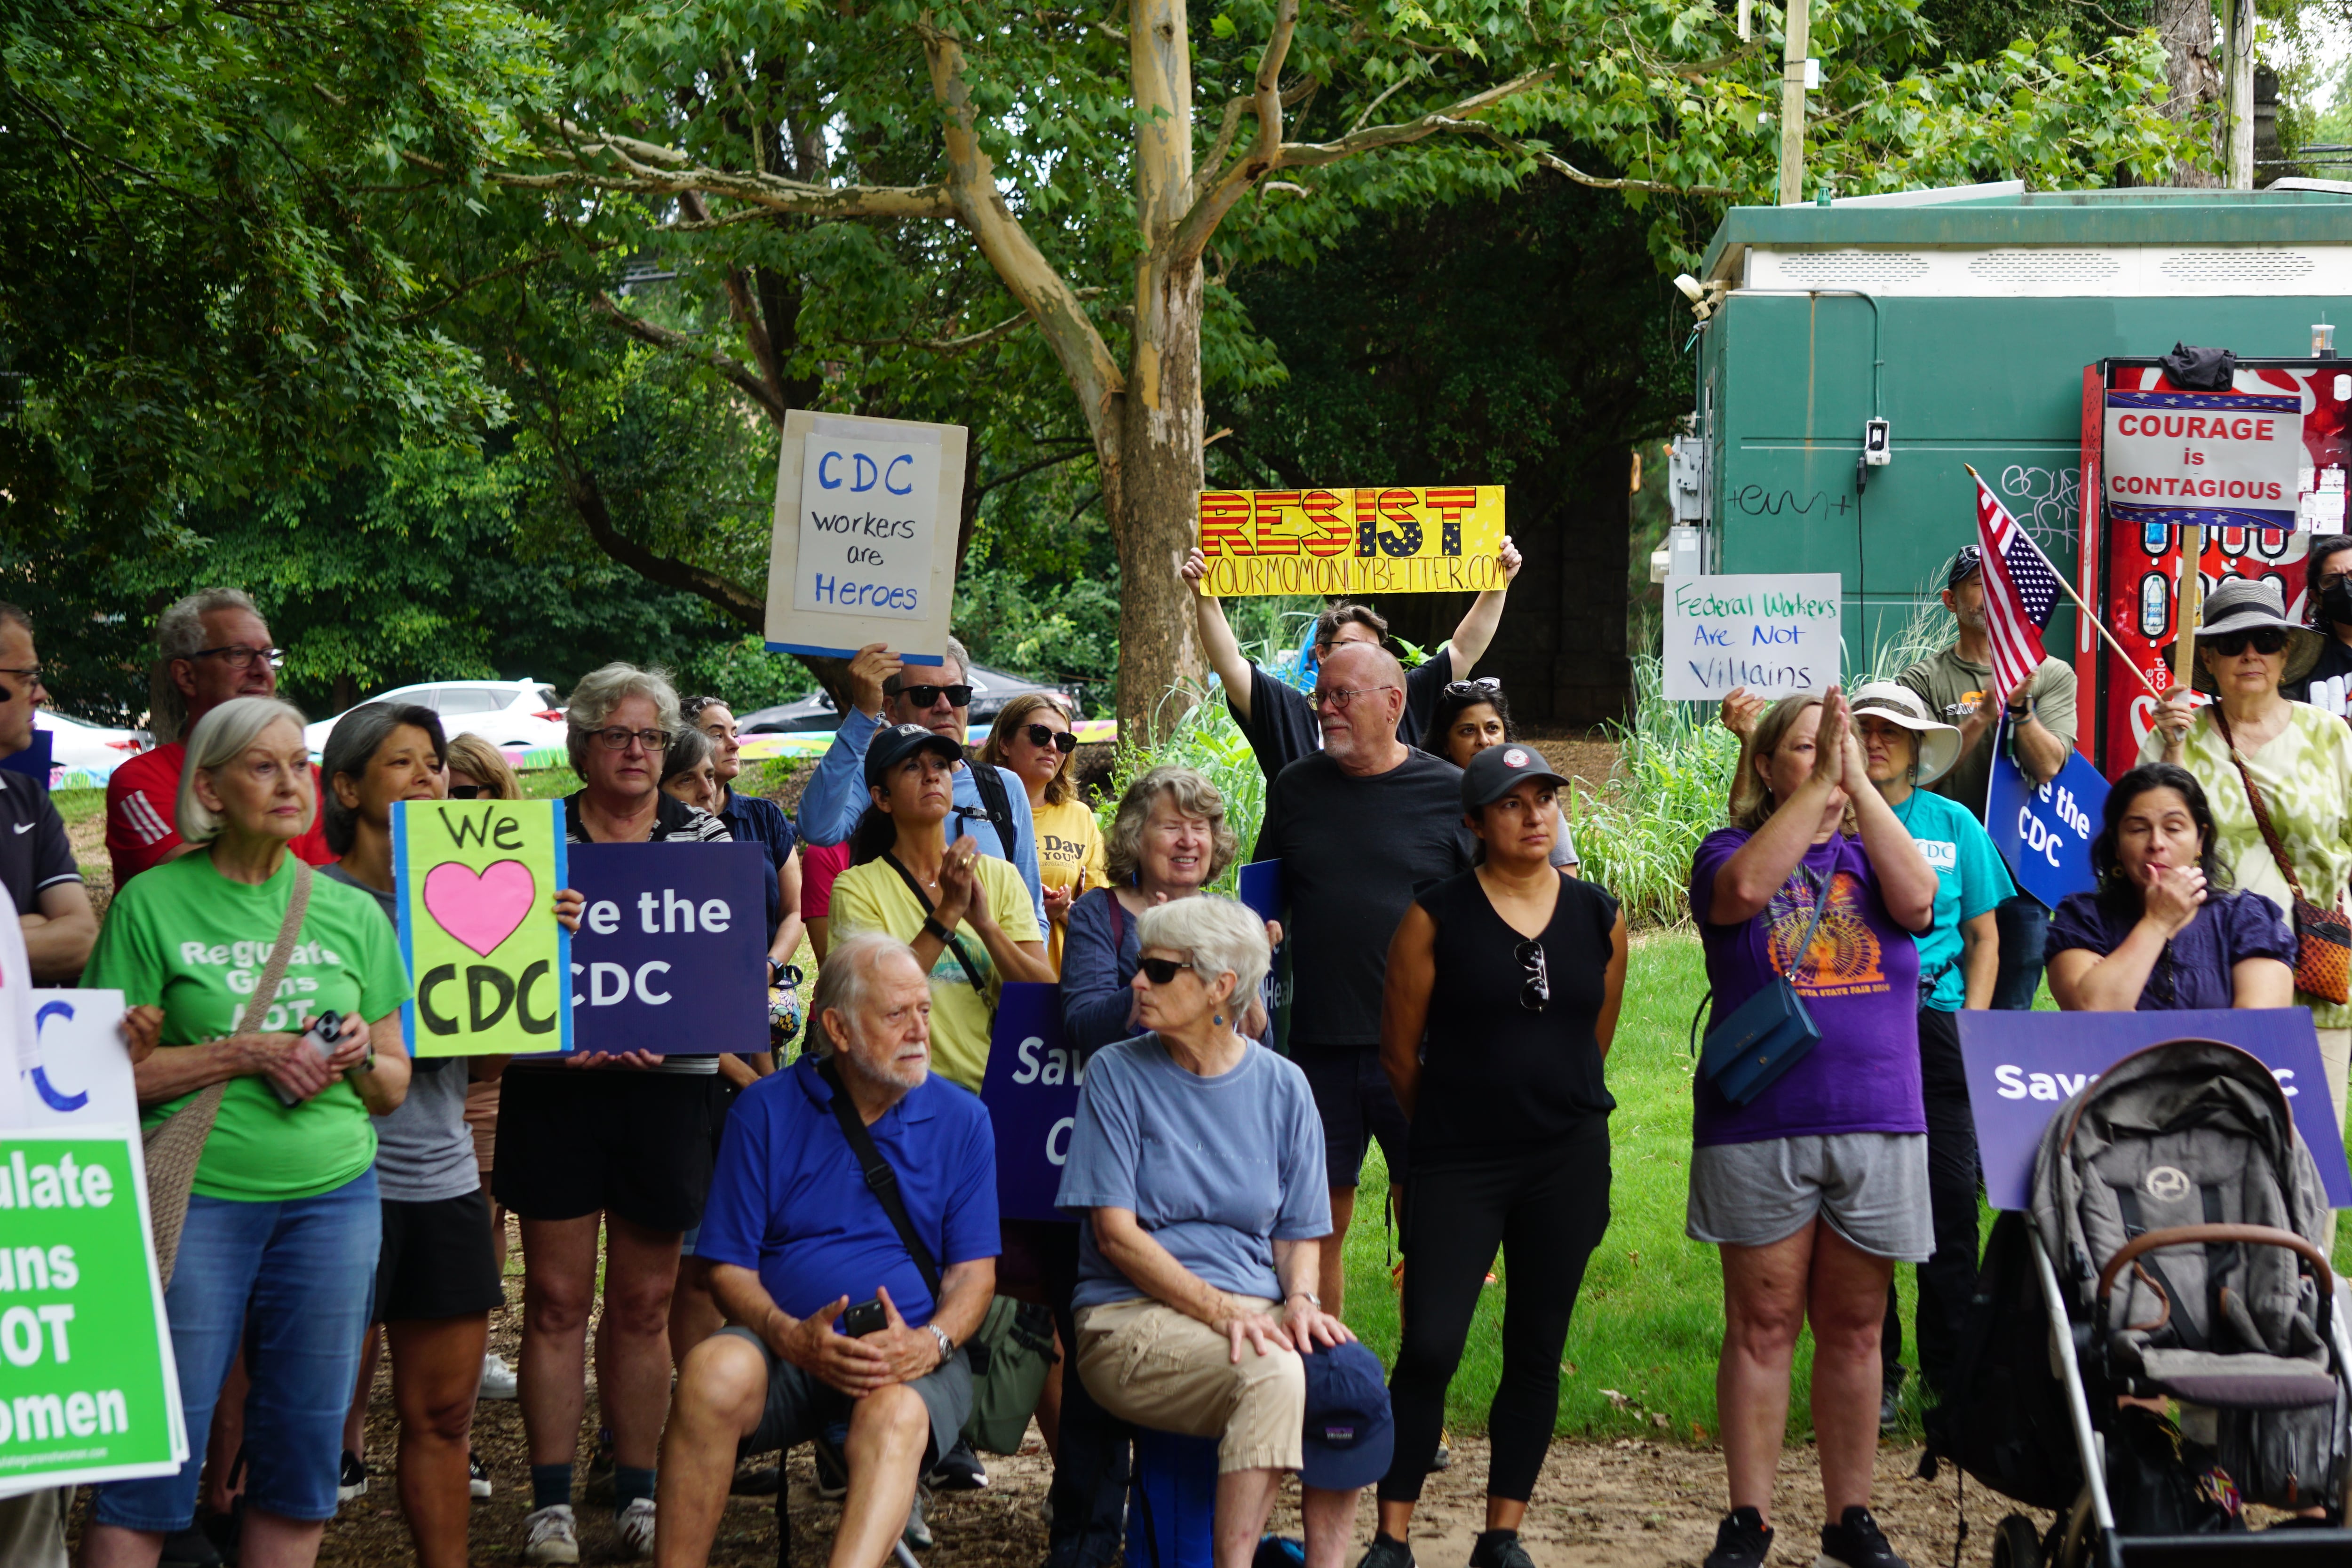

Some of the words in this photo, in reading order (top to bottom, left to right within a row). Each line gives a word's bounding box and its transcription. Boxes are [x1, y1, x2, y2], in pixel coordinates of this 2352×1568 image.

[2118, 414, 2275, 441] COURAGE
[2184, 447, 2204, 466] is
[819, 451, 914, 495] CDC
[2112, 475, 2282, 501] CONTAGIOUS
[811, 511, 915, 539] workers
[1200, 487, 1477, 557] RESIST
[847, 546, 884, 565] are
[816, 573, 917, 610] Heroes
[1675, 582, 1753, 618] Federal
[1763, 592, 1836, 620] Workers
[1694, 623, 1735, 646] Are
[1752, 624, 1807, 646] Not
[1688, 657, 1812, 689] Villains
[2154, 657, 2166, 690] cold
[437, 805, 524, 850] We
[2056, 785, 2090, 839] the
[1043, 835, 1086, 860] Day
[1917, 842, 1954, 859] CDC
[2018, 805, 2063, 867] CDC
[1042, 852, 1074, 864] YOU!
[637, 889, 731, 934] the
[180, 939, 342, 968] Reguate
[226, 969, 319, 997] Gns
[418, 959, 556, 1035] CDC
[1819, 987, 1849, 996] STATE
[1850, 985, 1872, 994] FAIR
[1994, 1064, 2100, 1101] Sav
[0, 1304, 76, 1367] OT
